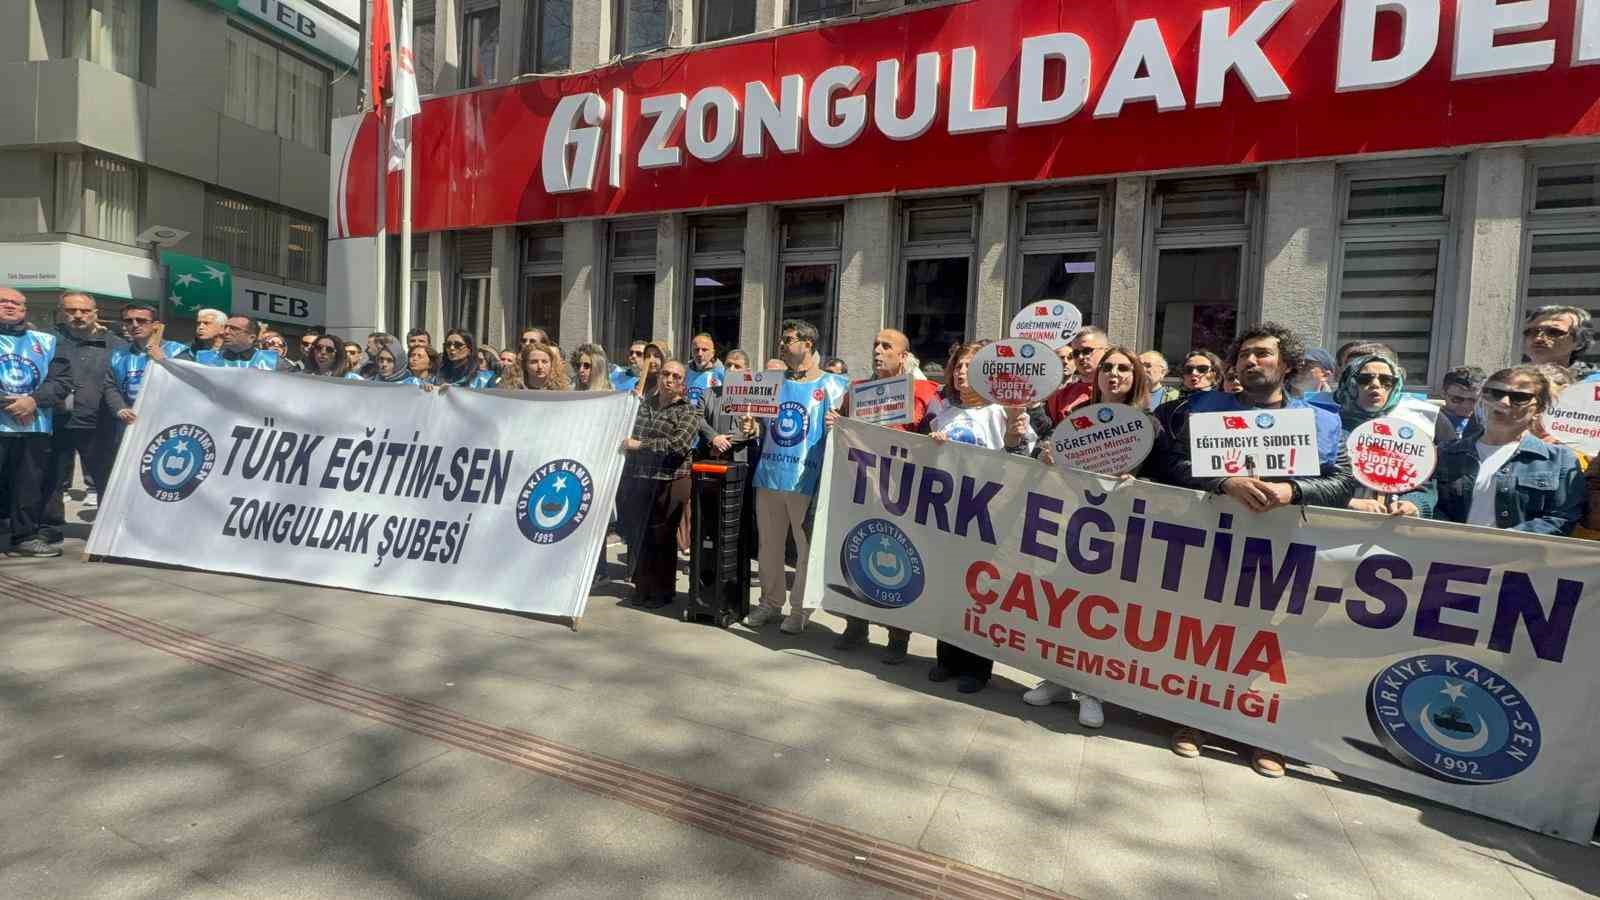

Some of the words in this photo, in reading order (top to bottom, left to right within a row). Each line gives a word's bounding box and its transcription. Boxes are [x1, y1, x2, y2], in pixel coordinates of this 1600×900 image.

[638, 0, 1295, 169] ZONGULDAK
[1335, 0, 1600, 93] DE
[245, 289, 309, 318] TEB
[982, 360, 1047, 376] ÖĞRETMENE
[222, 416, 325, 486] TÜRK
[319, 426, 514, 505] EĞİTİM-SEN
[1055, 419, 1144, 453] ÖĞRETMENLER
[1357, 432, 1426, 457] ÖĞRETMENE
[221, 496, 380, 555] ZONGULDAK
[373, 512, 472, 568] ŞUBESİ
[847, 445, 1004, 545] TÜRK
[1019, 489, 1584, 663] EĞİTİM-SEN
[965, 560, 1287, 685] ÇAYCUMA
[963, 608, 1026, 652] İLÇE
[1036, 637, 1281, 724] TEMSİLCİLİĞİ
[1378, 659, 1433, 733] TÜRKİYE
[1444, 659, 1534, 763] KAMU-SEN
[1433, 752, 1483, 775] 1992
